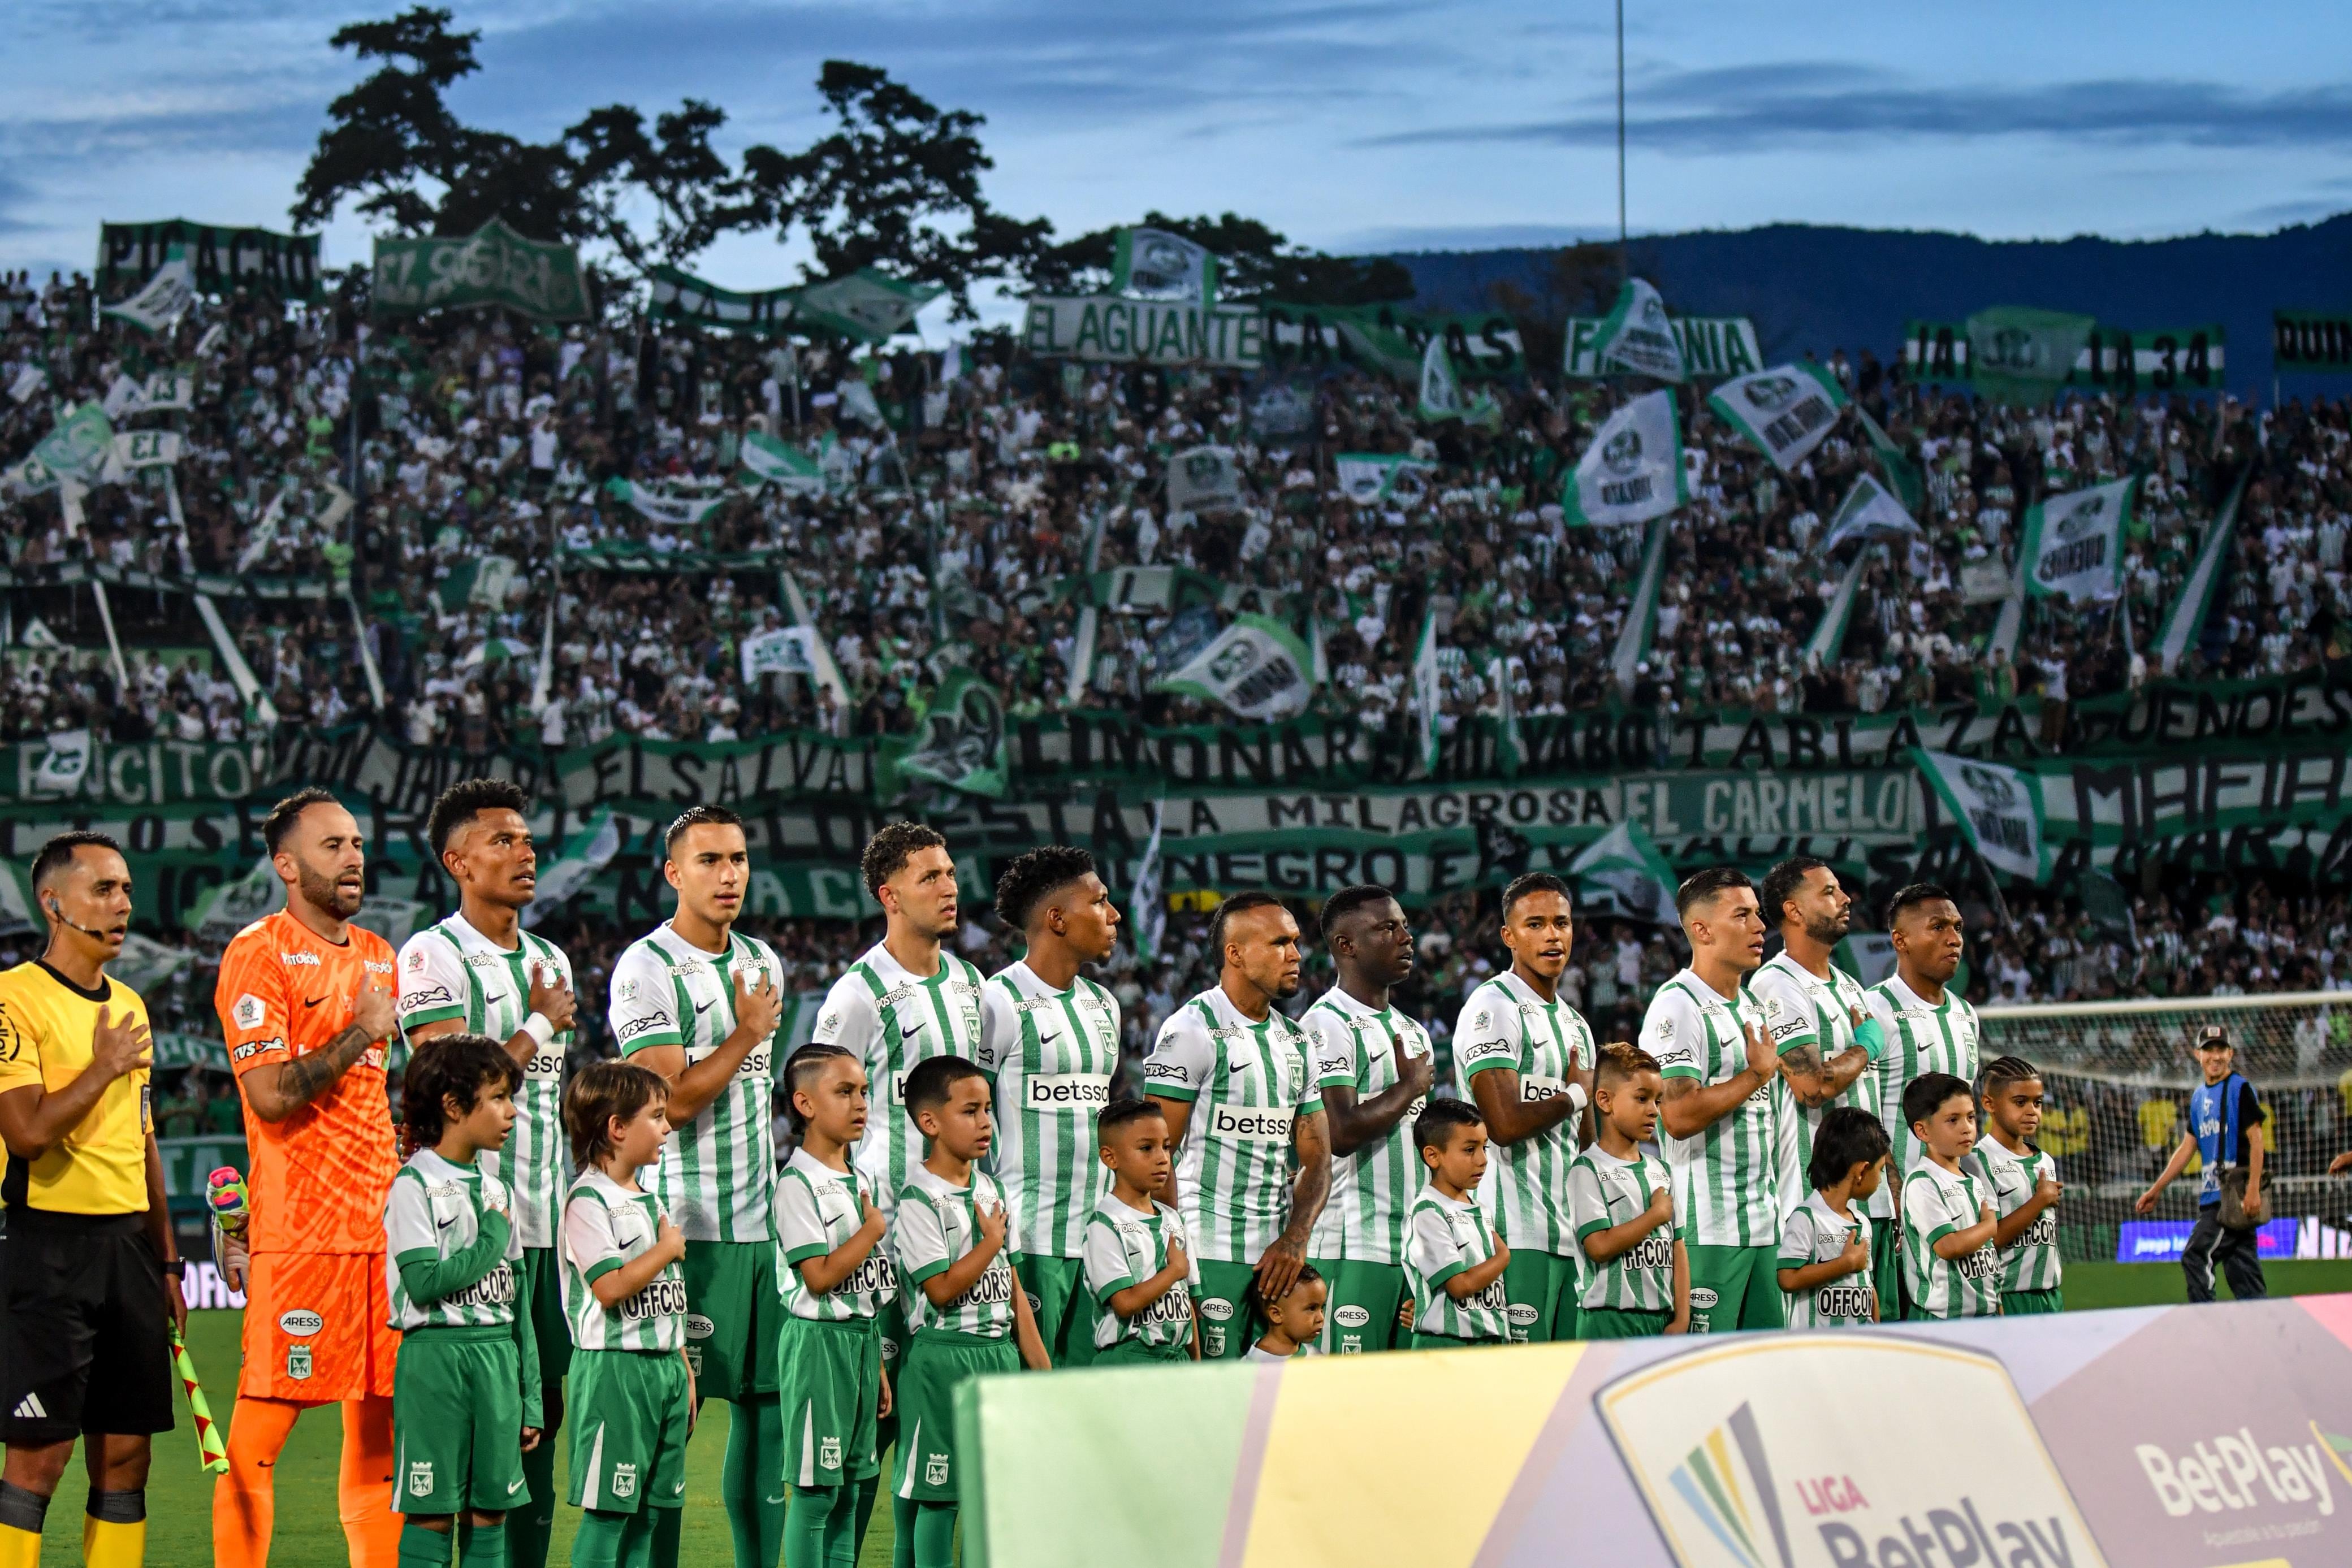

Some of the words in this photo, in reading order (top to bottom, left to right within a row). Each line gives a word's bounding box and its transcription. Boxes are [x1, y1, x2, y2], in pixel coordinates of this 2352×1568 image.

[1028, 304, 1069, 353] EL
[1074, 300, 1263, 362] AGUANTE
[1675, 700, 2042, 769] TABLAZA
[671, 735, 875, 806] SALVA
[1266, 789, 1612, 834] MILAGROSA
[1624, 780, 1679, 835] EL
[1703, 770, 1907, 835] CARMELO
[619, 1020, 640, 1043] TVS
[233, 1041, 257, 1063] TVS
[1145, 1064, 1161, 1077] TVS
[1032, 1080, 1110, 1102] betsso
[1217, 1110, 1292, 1136] betsso
[1201, 1303, 1232, 1315] ARESS
[1335, 1310, 1367, 1320] ARESS
[1817, 1287, 1872, 1317] OFFCOR
[283, 1316, 320, 1329] ARESS
[687, 1319, 712, 1332] RESS
[2134, 1427, 2335, 1517] BetPlay
[1795, 1475, 1871, 1517] LIGA
